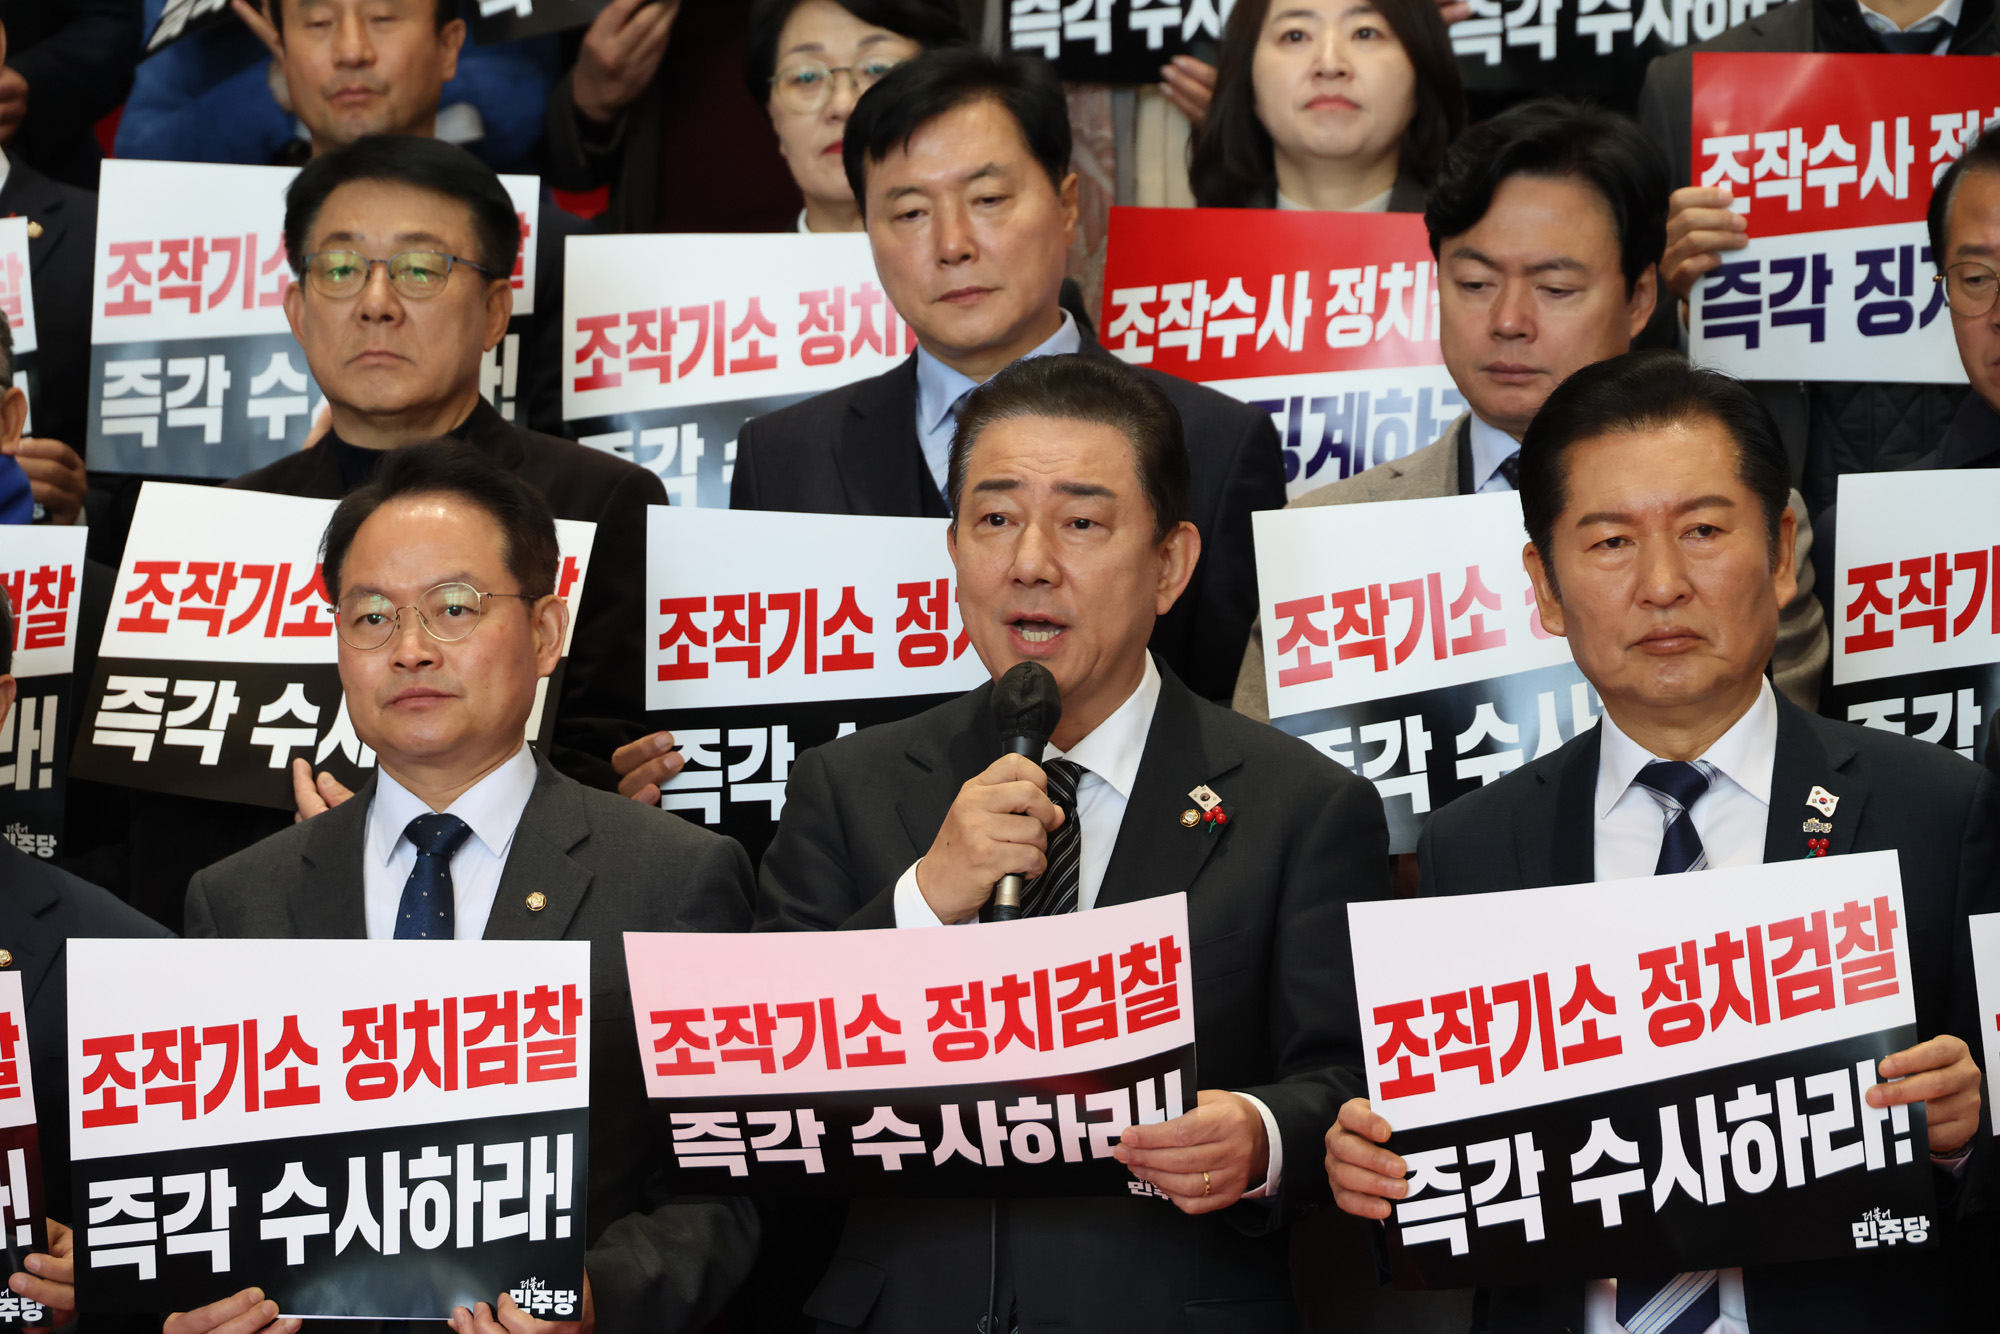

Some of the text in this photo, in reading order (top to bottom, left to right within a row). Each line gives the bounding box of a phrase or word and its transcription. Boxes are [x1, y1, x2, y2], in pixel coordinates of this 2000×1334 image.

[1010, 0, 1115, 59] 즉각
[1449, 0, 1563, 65] 즉각
[1701, 116, 1914, 217] 조작수사
[574, 297, 777, 392] 조작기소
[798, 282, 918, 366] 정치
[1108, 261, 1440, 365] 조작수사 정치
[1701, 254, 1833, 349] 즉각
[101, 355, 231, 447] 즉각
[247, 352, 331, 440] 수
[117, 561, 334, 638] 조작기소
[658, 578, 972, 682] 조작기소 정
[1274, 565, 1507, 688] 조작기소
[1845, 545, 2000, 654] 조작기
[92, 675, 240, 766] 즉각
[1455, 682, 1603, 787] 수사
[661, 725, 795, 824] 즉각
[650, 934, 1182, 1076] 조작기소 정치검찰
[1373, 896, 1900, 1101] 조작기소 정치검찰
[82, 1015, 320, 1129] 조작기소
[342, 984, 582, 1101] 정치검찰
[669, 1109, 825, 1177] 즉각
[1396, 1056, 1913, 1256] 즉각 수사하라!
[87, 1168, 236, 1280] 즉각
[260, 1133, 574, 1266] 수사하라!
[1852, 1216, 1930, 1249] 민주당
[510, 1289, 578, 1315] 민주당
